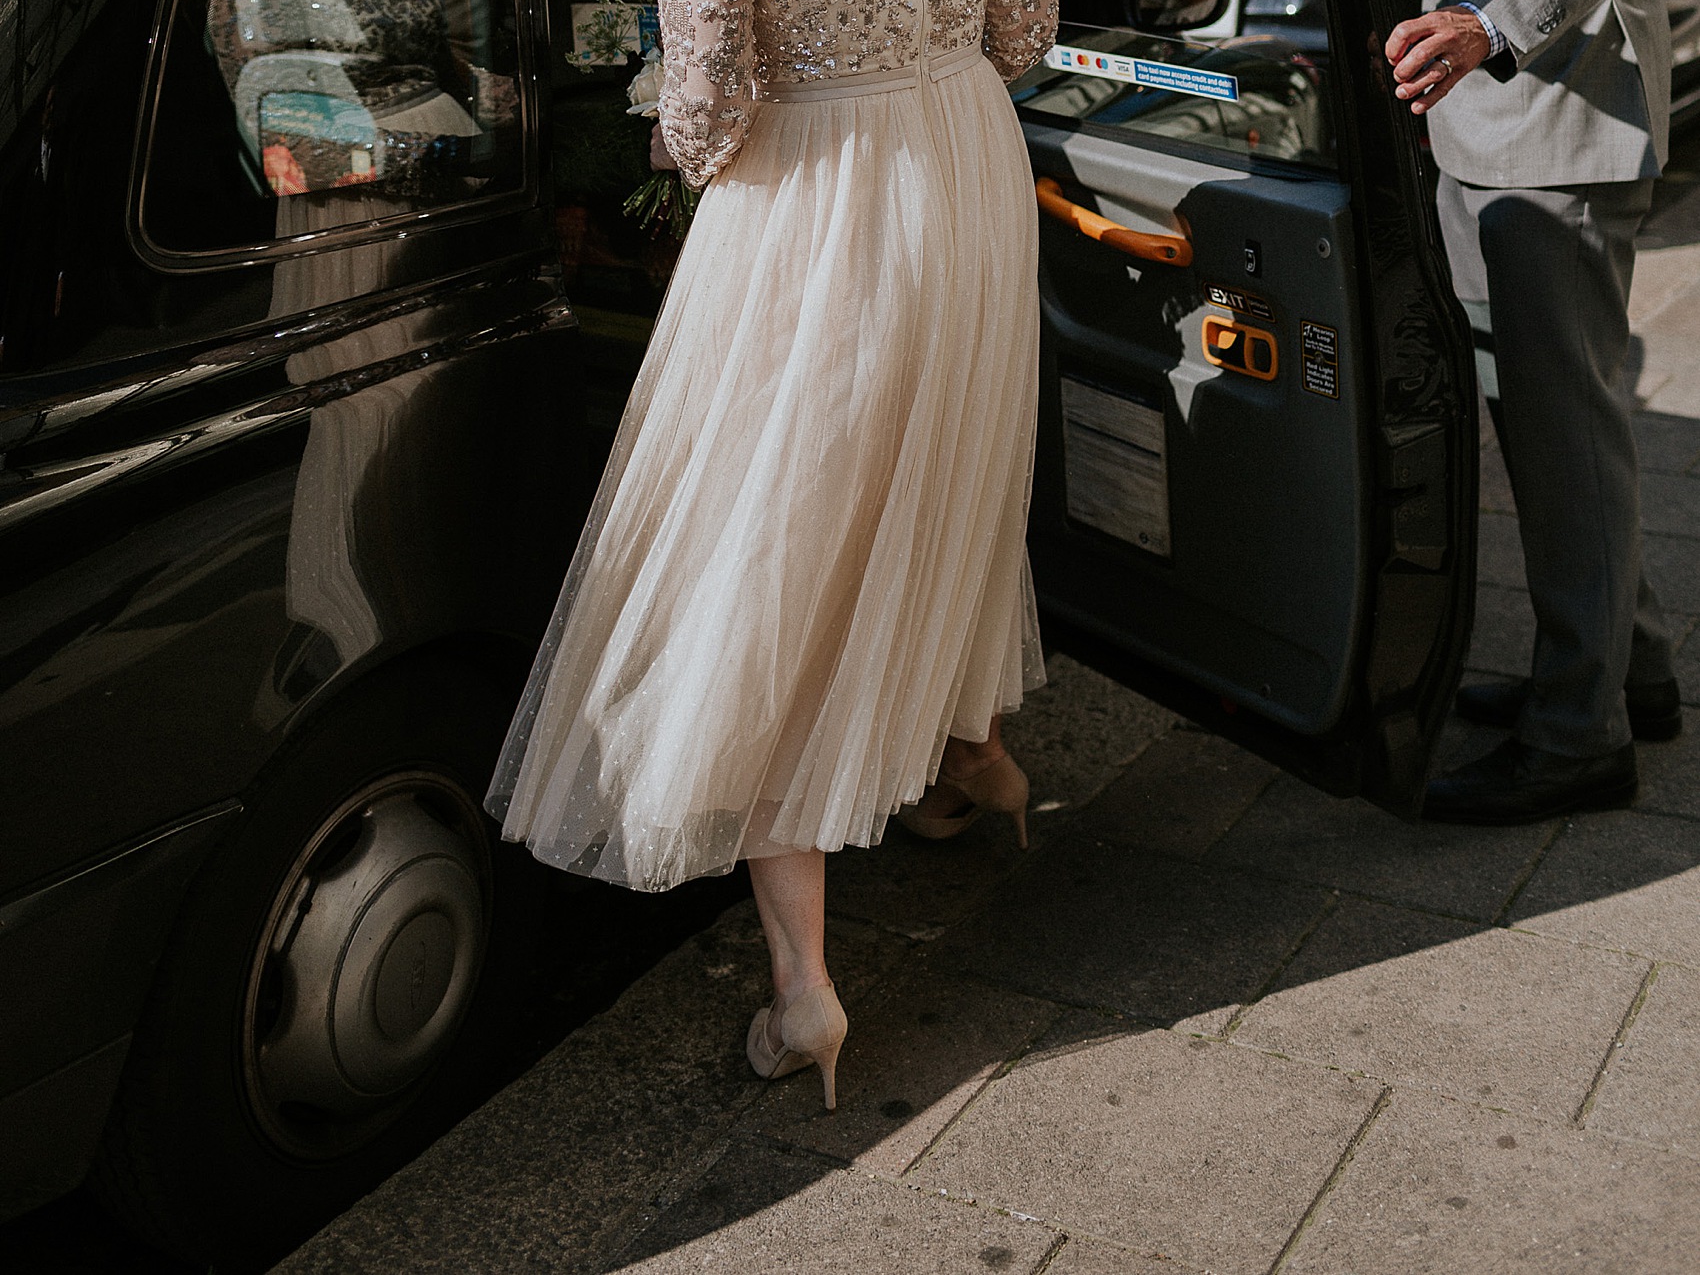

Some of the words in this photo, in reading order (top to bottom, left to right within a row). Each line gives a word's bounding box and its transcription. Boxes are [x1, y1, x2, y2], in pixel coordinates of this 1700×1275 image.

[1136, 63, 1149, 73] This
[1148, 66, 1159, 75] taxi
[1159, 69, 1171, 77] now
[1171, 71, 1192, 82] accepts
[1191, 75, 1207, 84] credit
[1207, 77, 1218, 86] and
[1218, 79, 1233, 89] debit
[1137, 73, 1150, 81] card
[1150, 75, 1175, 86] payments
[1175, 79, 1199, 91] including
[1198, 84, 1230, 96] contactless
[1209, 287, 1244, 309] EXIT
[1312, 327, 1334, 339] Hearing
[1316, 333, 1332, 344] Loop
[1306, 360, 1318, 370] Red
[1318, 365, 1334, 375] Light
[1306, 368, 1334, 382] Indicates
[1306, 374, 1324, 386] Doors
[1324, 380, 1335, 389] Are
[1309, 382, 1333, 395] Secured
